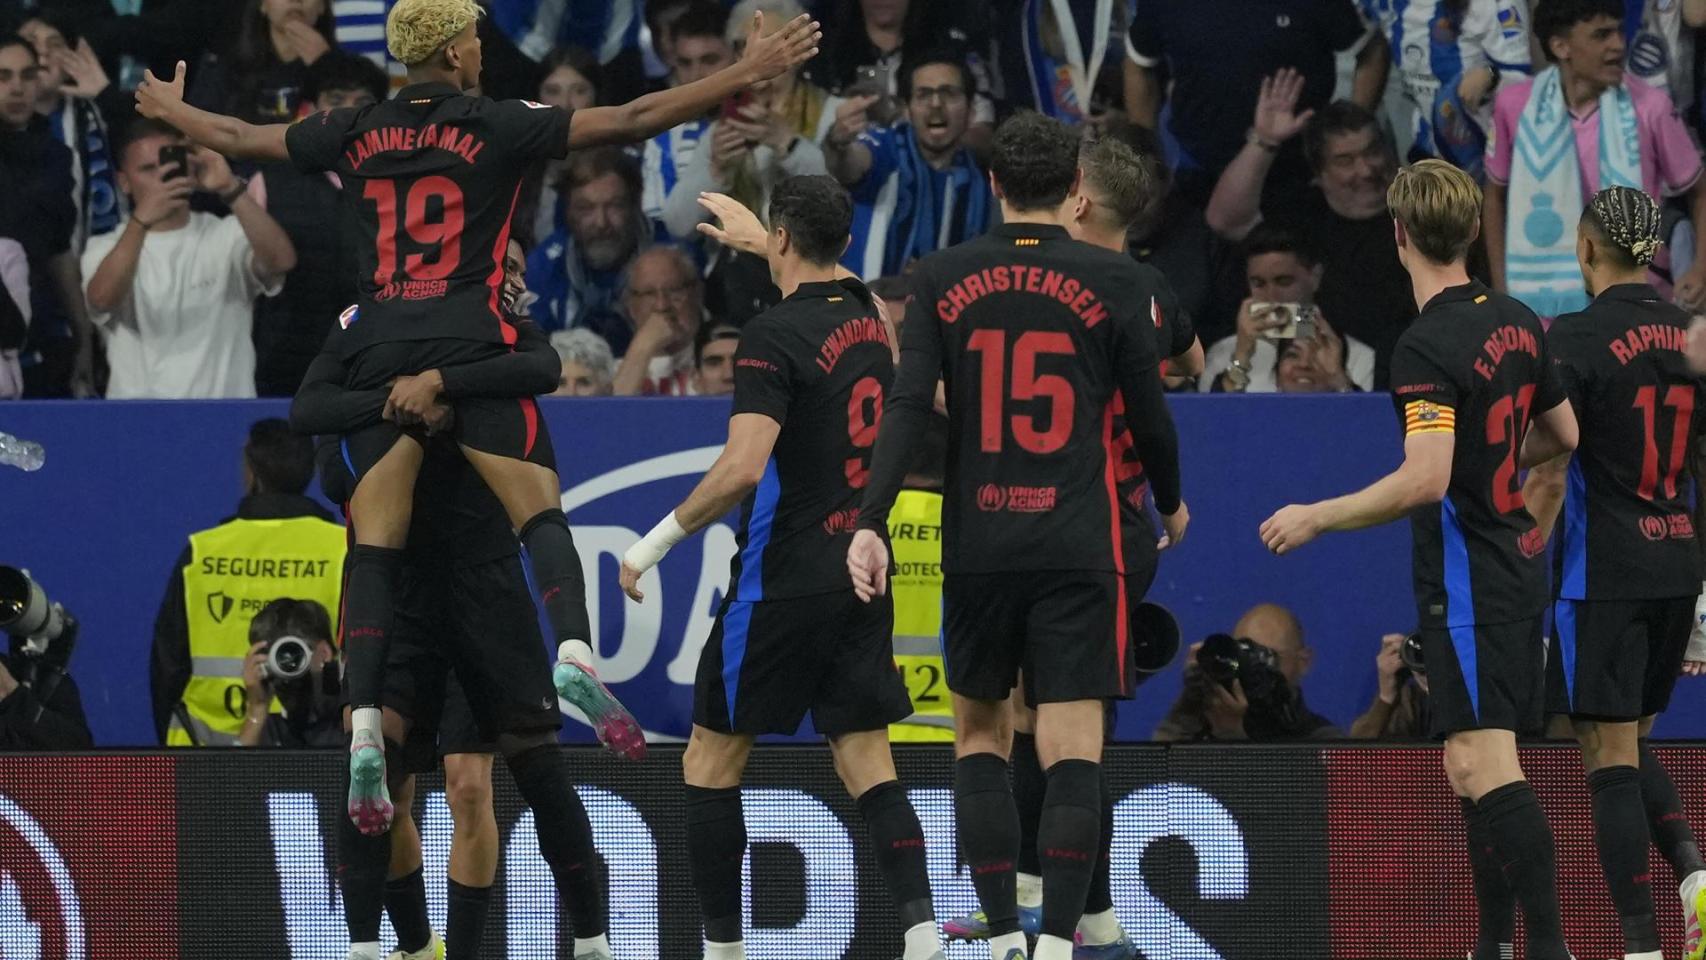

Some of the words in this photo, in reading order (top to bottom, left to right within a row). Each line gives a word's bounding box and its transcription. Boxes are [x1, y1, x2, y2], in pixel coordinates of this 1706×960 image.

[346, 126, 417, 171] LAMINE
[363, 175, 465, 285] 19
[403, 280, 448, 290] UNHCR
[937, 265, 1109, 328] CHRISTENSEN
[1609, 324, 1689, 366] RAPHIN
[967, 328, 1076, 454] 15
[845, 376, 884, 489] 9
[1632, 385, 1695, 500] 11
[1007, 496, 1056, 508] ACNUR
[1008, 486, 1057, 497] UNHCR
[202, 556, 329, 578] SEGURETAT
